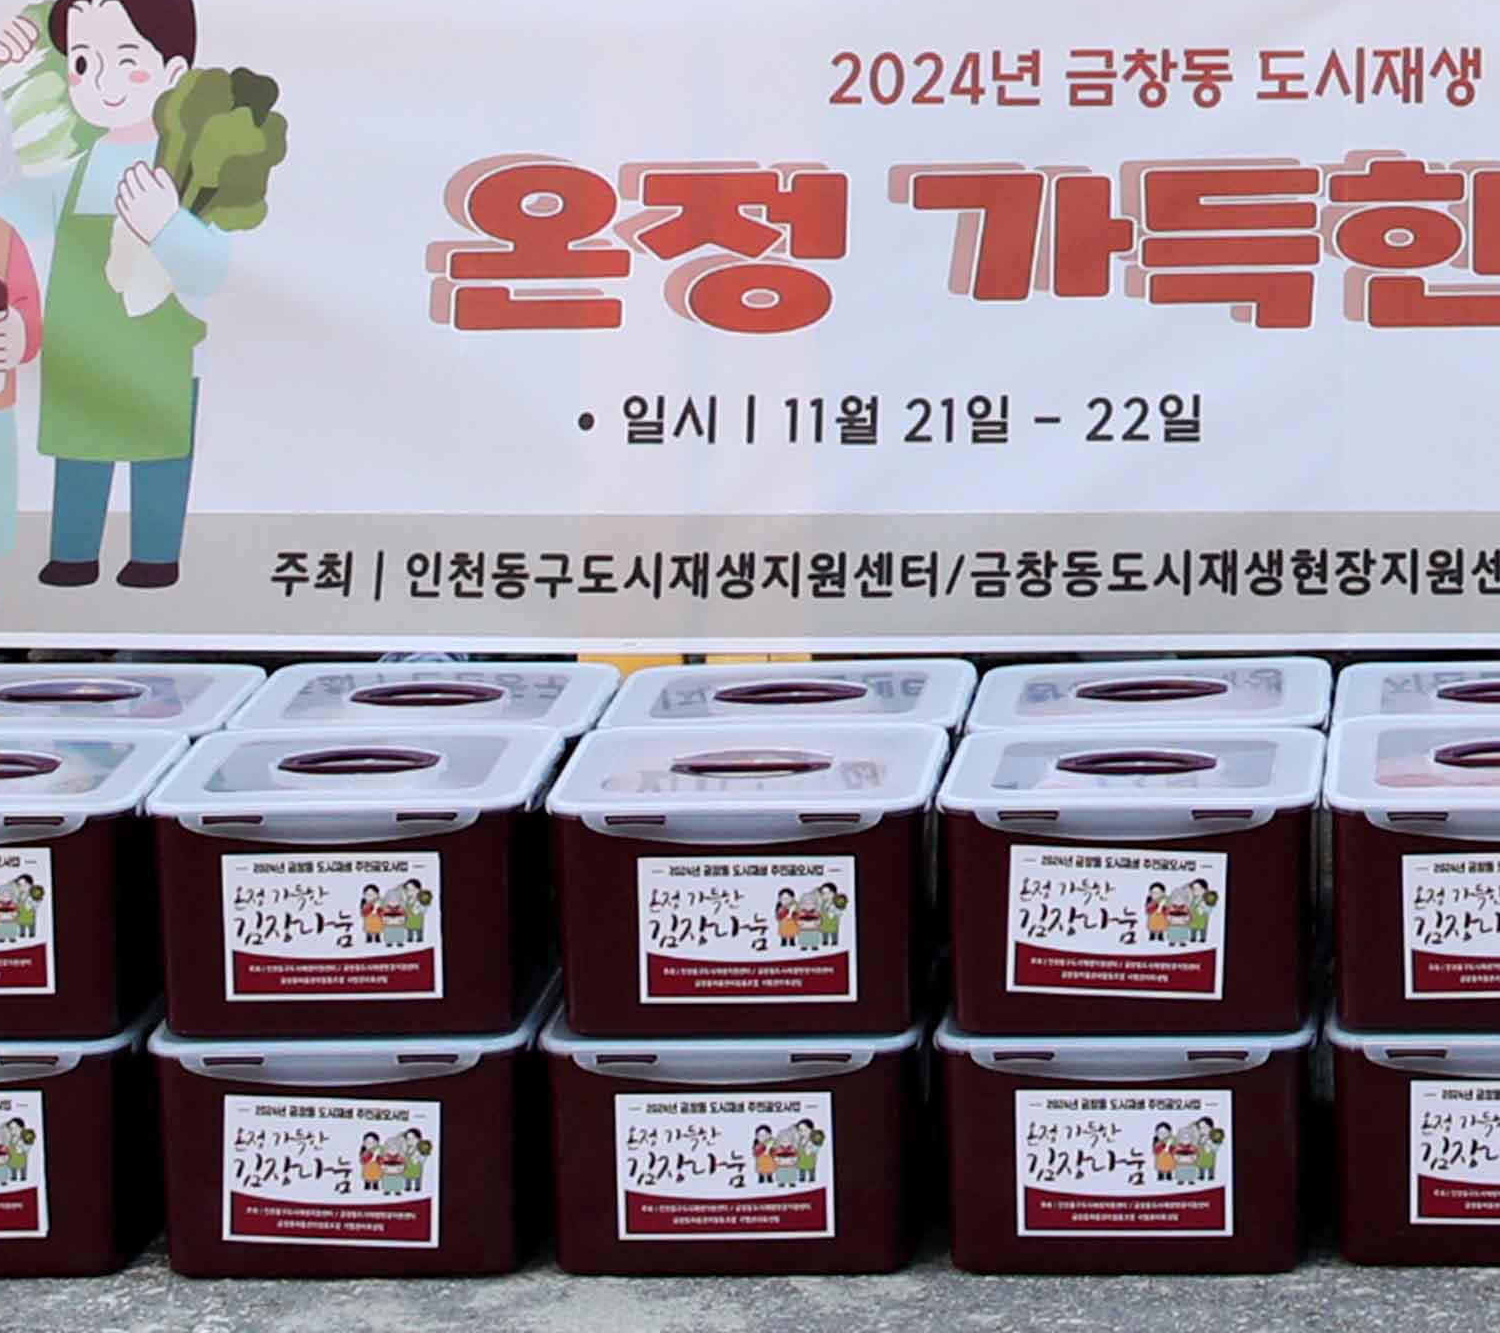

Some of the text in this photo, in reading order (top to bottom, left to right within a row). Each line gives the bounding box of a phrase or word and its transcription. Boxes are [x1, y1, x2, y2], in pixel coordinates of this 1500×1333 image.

[832, 51, 1041, 106] 2024년
[1067, 49, 1231, 108] 금창동
[1260, 49, 1481, 106] 도시재생
[432, 153, 848, 333] 온정
[623, 395, 716, 444] 일시
[785, 395, 878, 445] 11월
[904, 395, 1008, 444] 21일
[1086, 394, 1200, 442] 22일
[271, 551, 353, 598] 주최
